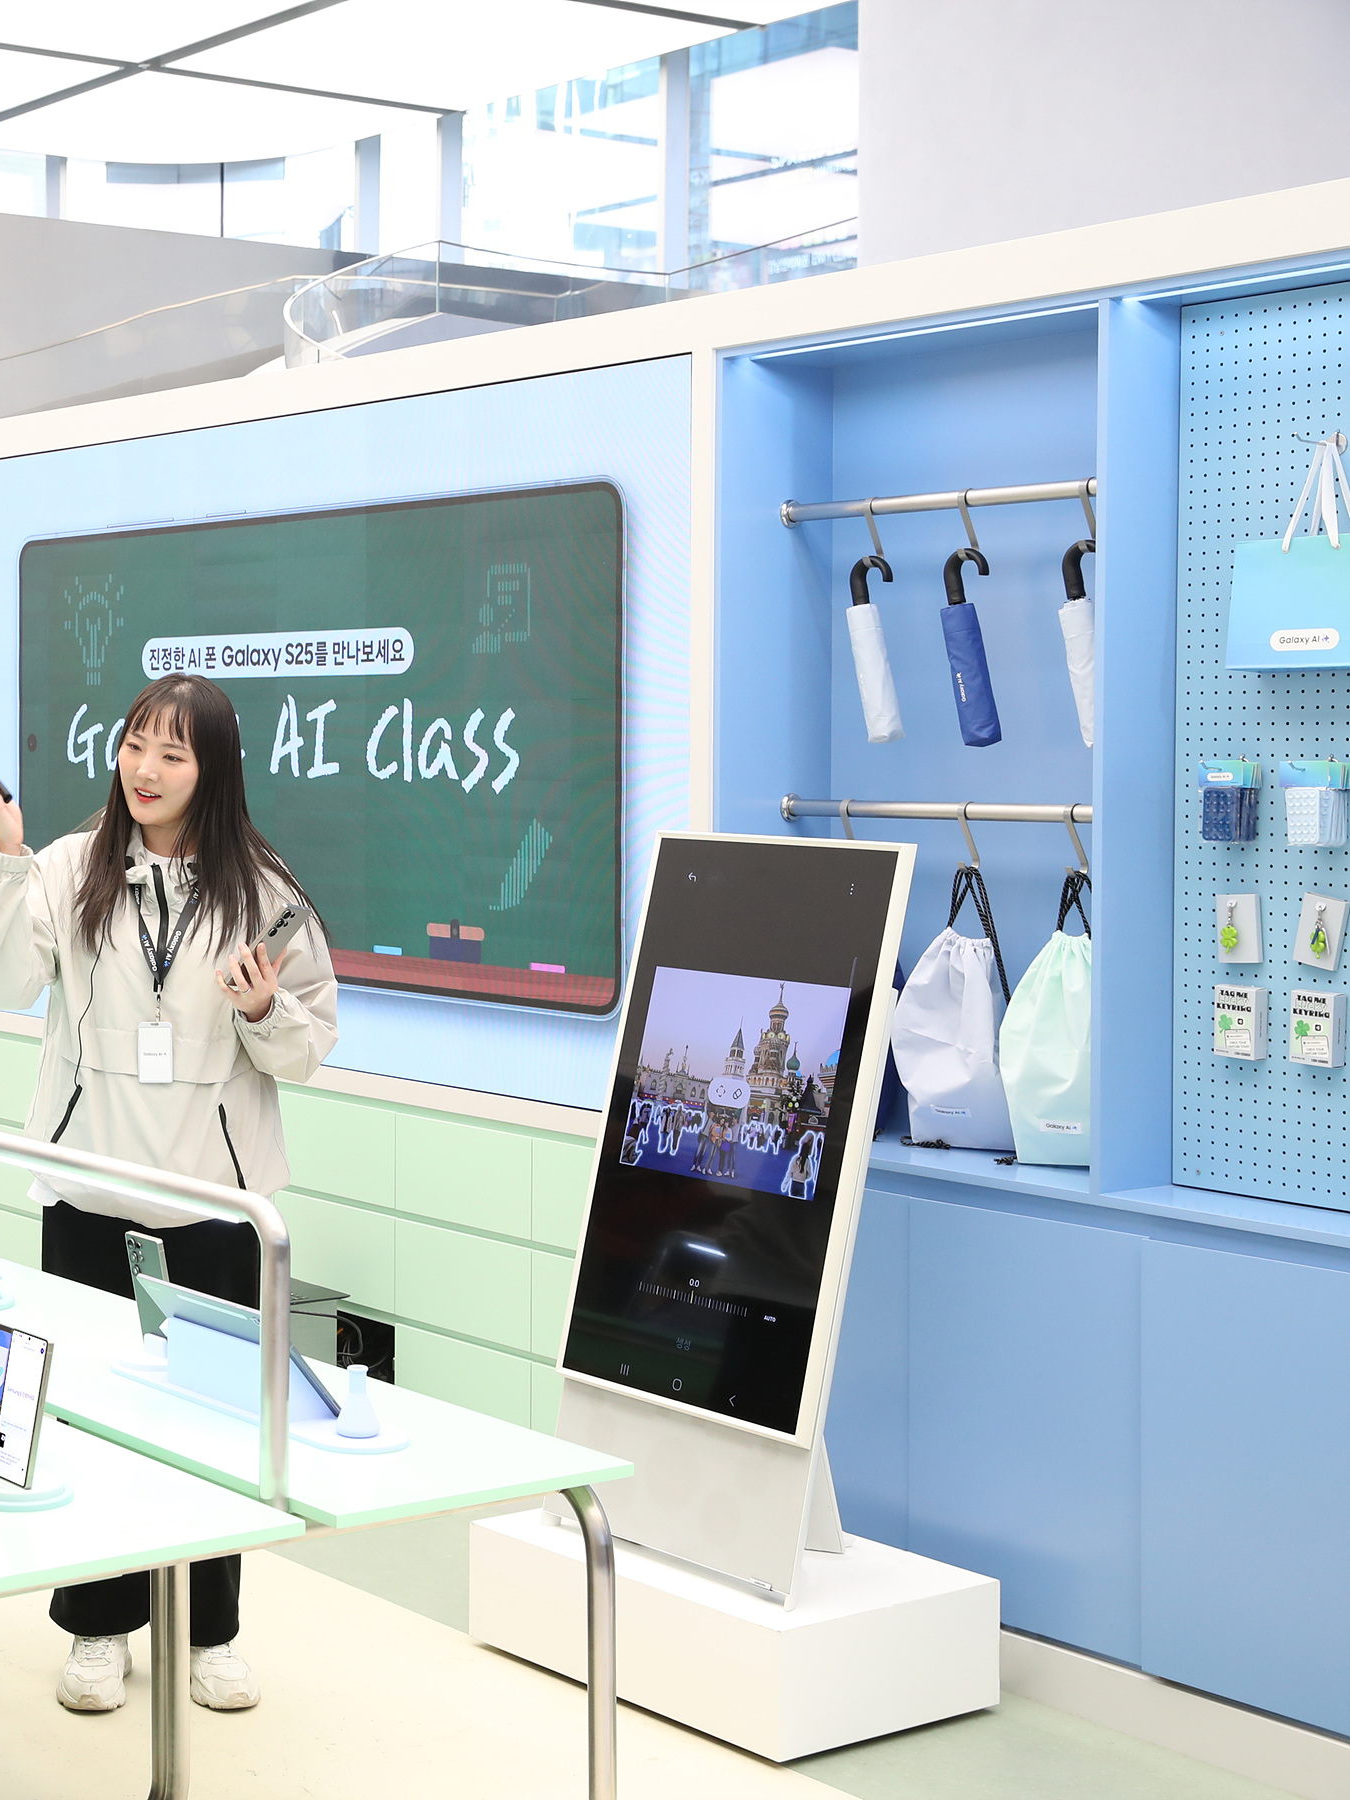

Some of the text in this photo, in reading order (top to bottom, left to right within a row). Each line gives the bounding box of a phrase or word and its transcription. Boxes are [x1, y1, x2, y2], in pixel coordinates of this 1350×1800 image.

[1278, 636, 1310, 645] Galaxy
[149, 639, 405, 671] 진정한 AI 폰 Galaxy S25를 만나보세요
[269, 694, 521, 794] AI Class
[166, 930, 182, 960] Galaxy AI
[146, 946, 158, 972] Galaxy
[1216, 1002, 1252, 1012] KEYRING
[1293, 1008, 1330, 1018] KEYRING
[689, 1278, 700, 1287] 0.0
